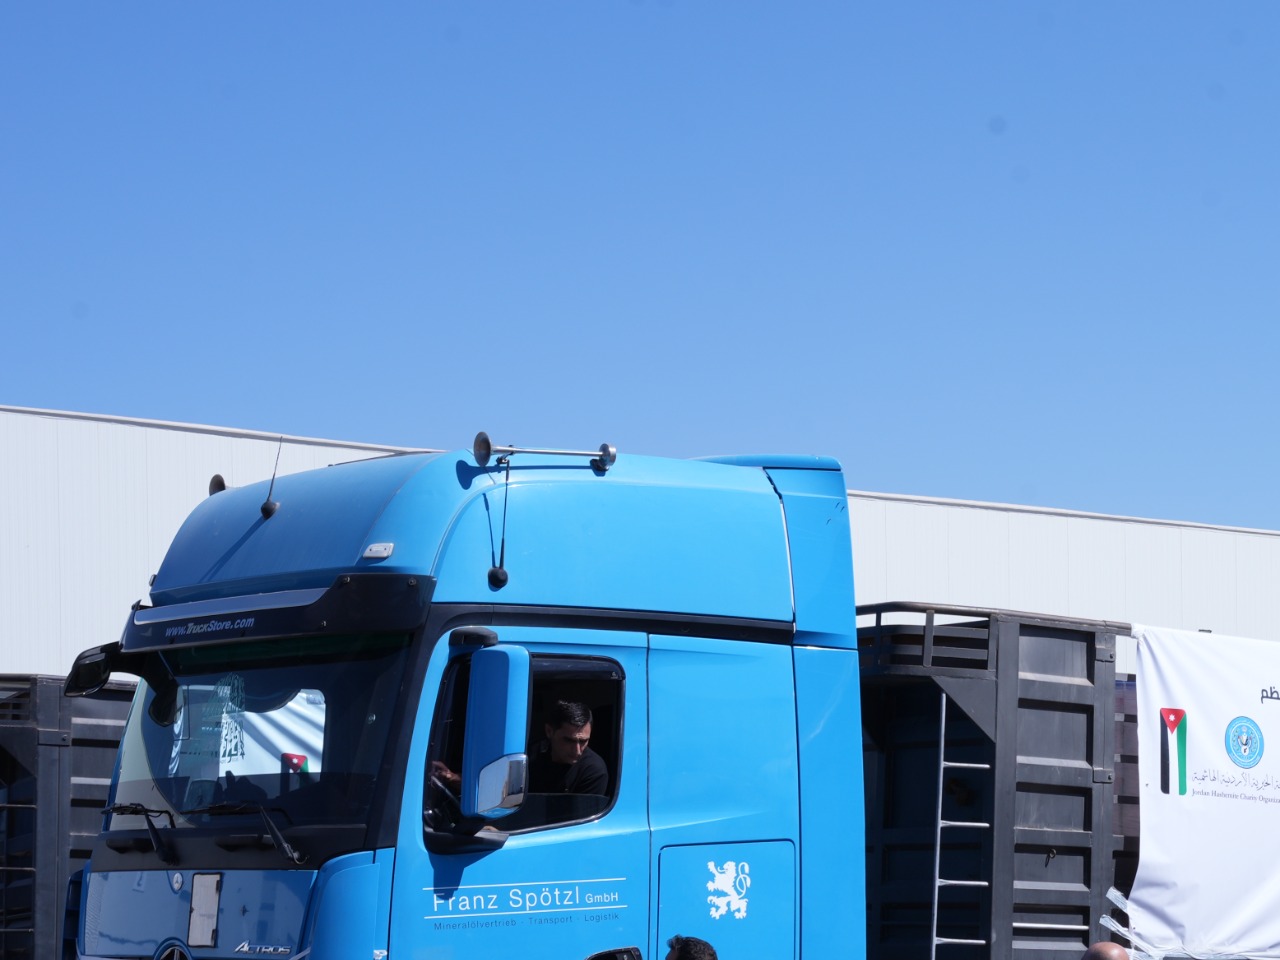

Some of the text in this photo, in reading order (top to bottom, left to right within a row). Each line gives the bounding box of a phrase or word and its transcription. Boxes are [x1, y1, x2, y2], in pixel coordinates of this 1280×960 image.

[165, 617, 255, 637] www.TruckStore.com
[1192, 788, 1210, 797] Jordan
[433, 885, 619, 911] Franz Spötzl GmbH
[434, 913, 620, 931] Mineralölvertrieb Transport Logistik
